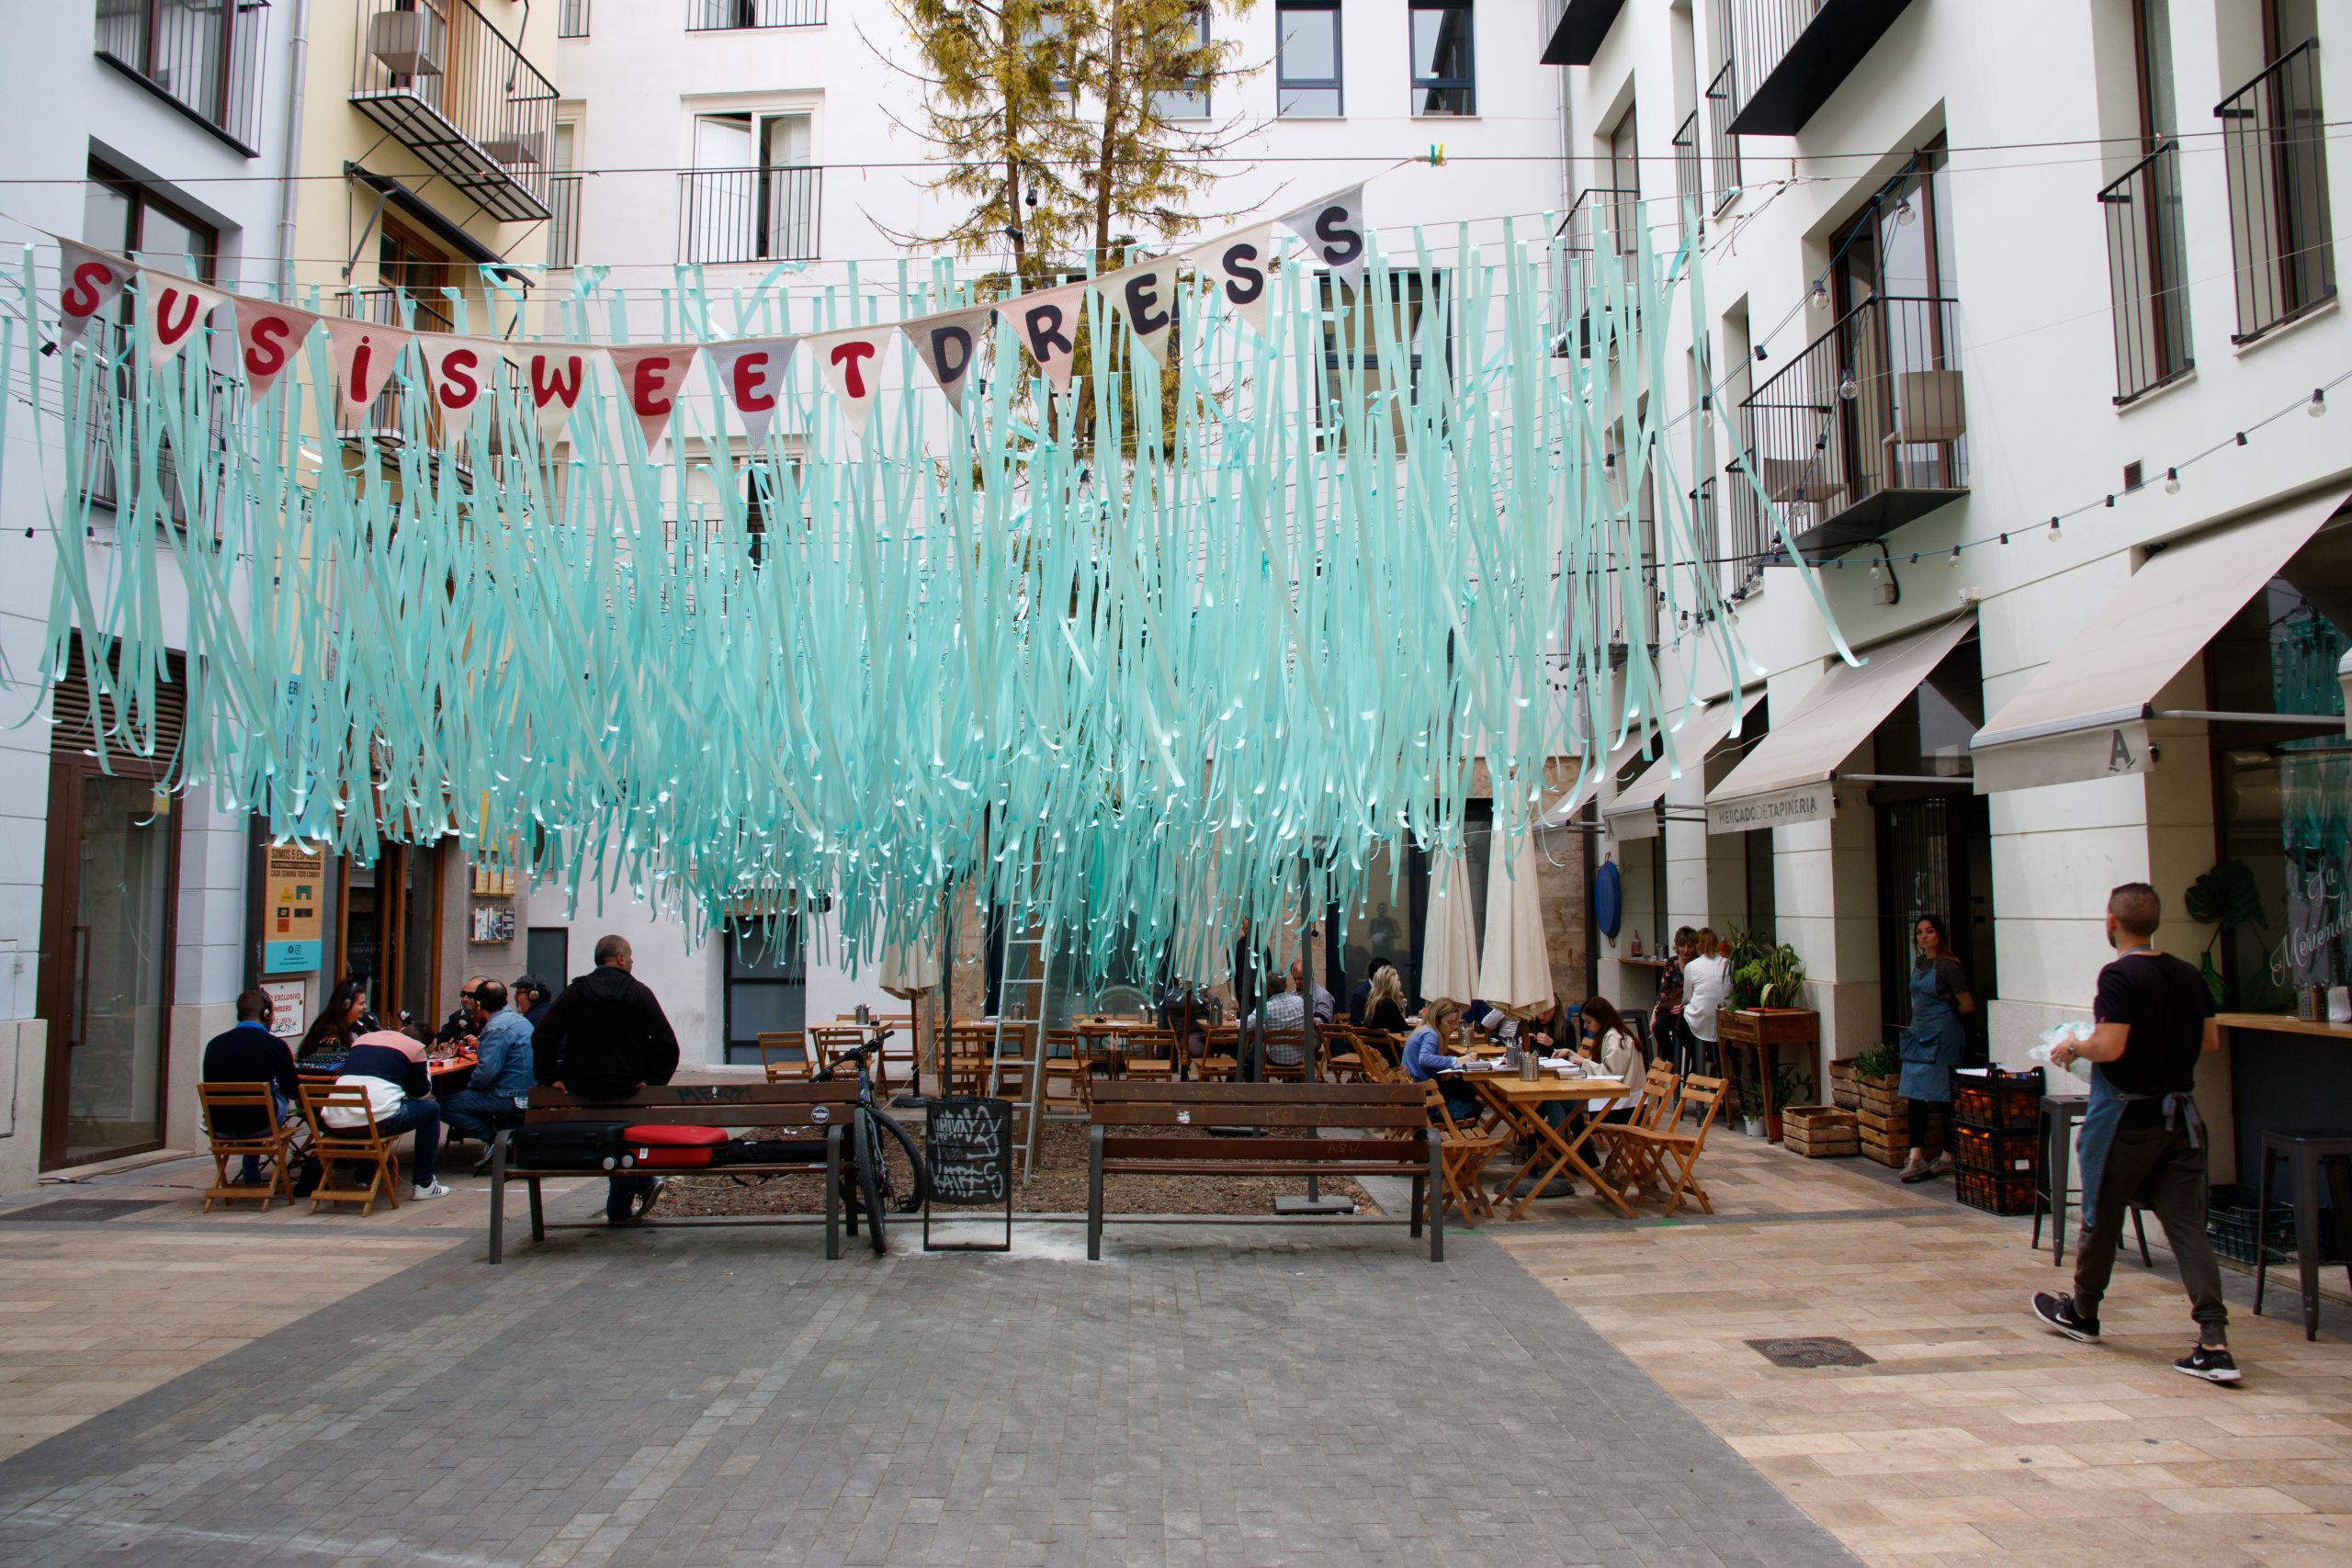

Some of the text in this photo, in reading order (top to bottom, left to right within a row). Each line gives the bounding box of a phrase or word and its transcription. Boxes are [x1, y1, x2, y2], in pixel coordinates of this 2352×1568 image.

[271, 849, 291, 860] SOMOS
[291, 849, 296, 860] 5
[2308, 856, 2342, 908] La
[275, 993, 301, 1001] EXCLUSIVO
